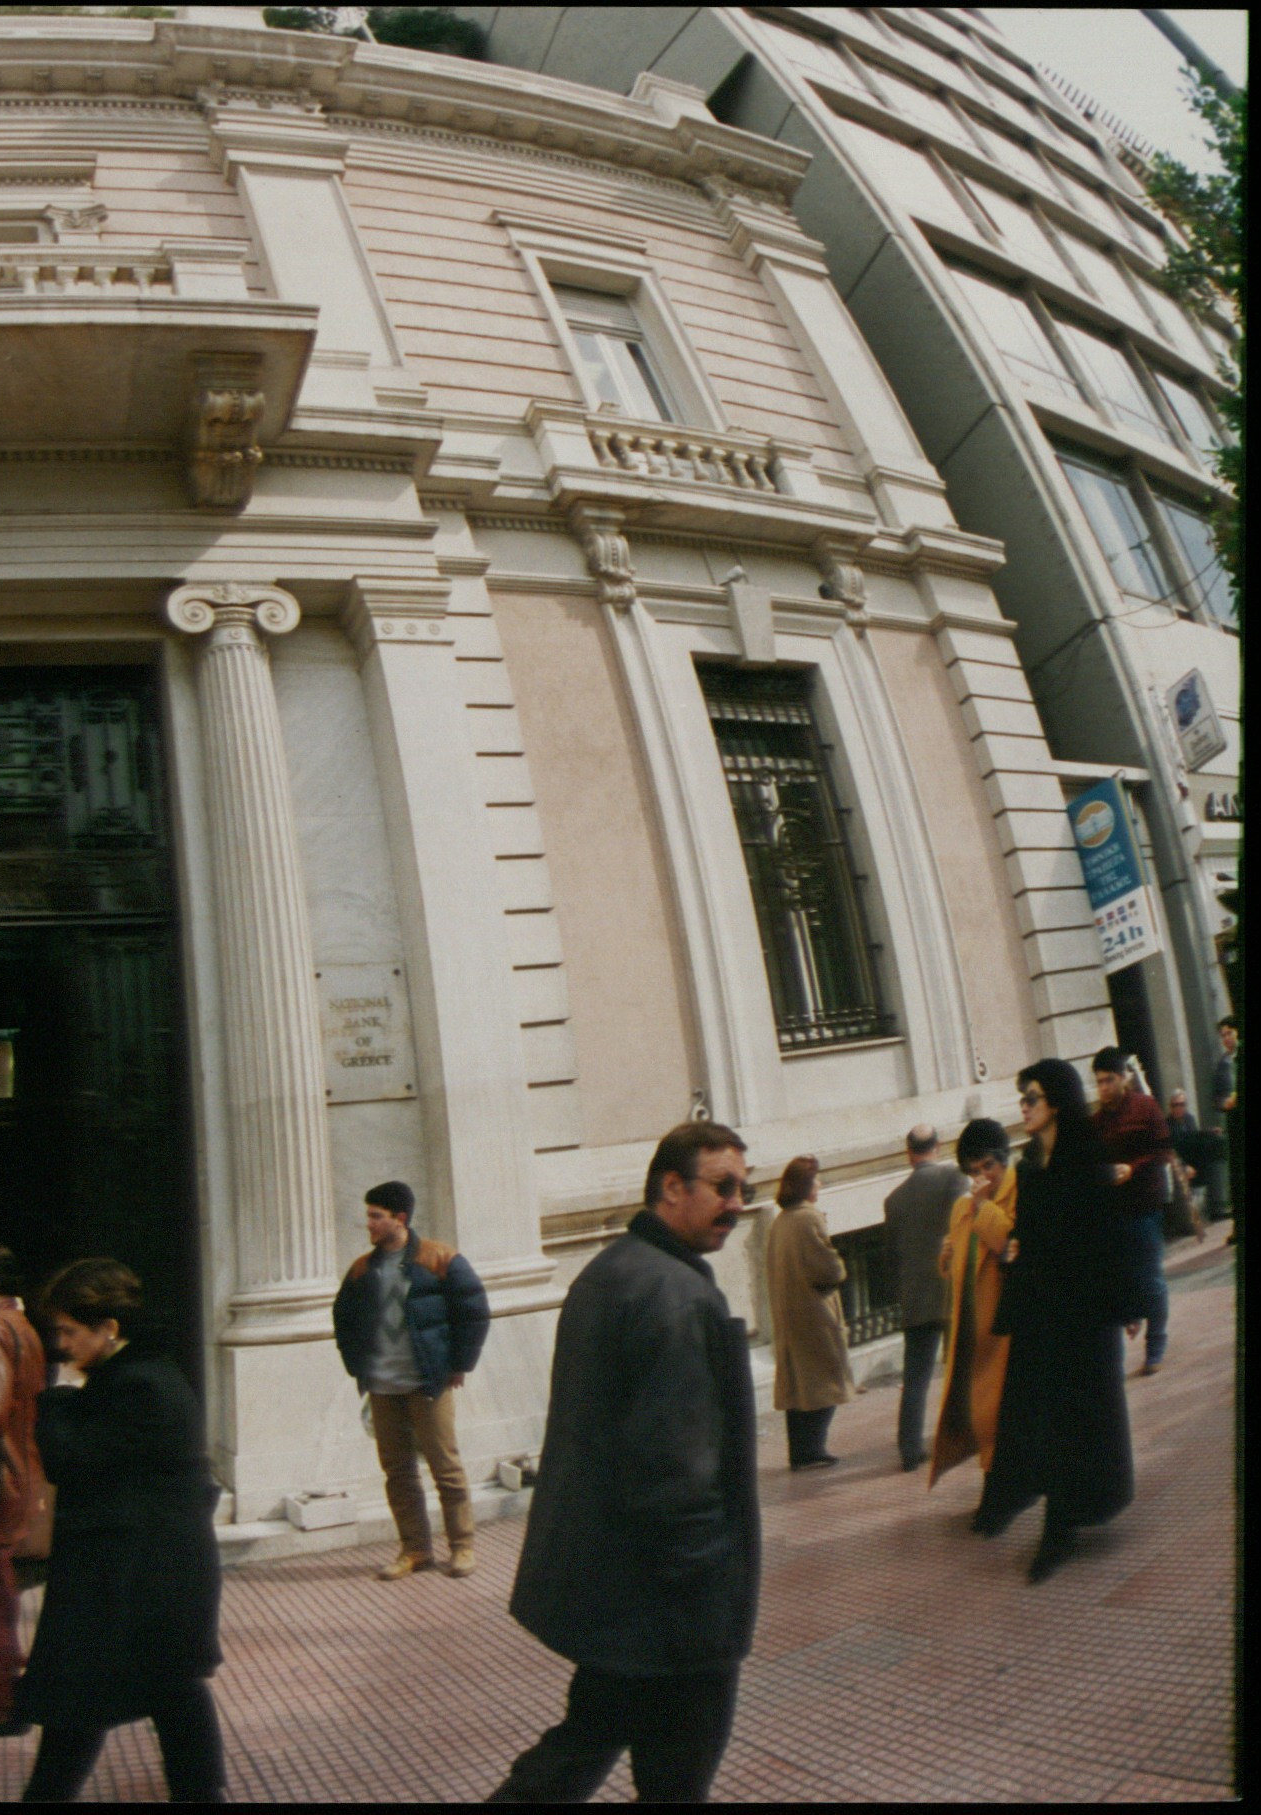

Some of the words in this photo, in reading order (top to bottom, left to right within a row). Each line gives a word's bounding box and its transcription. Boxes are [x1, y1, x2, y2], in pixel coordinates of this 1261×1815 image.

[343, 1016, 382, 1029] BANK
[355, 1036, 373, 1047] OF
[341, 1055, 393, 1068] GREECE
